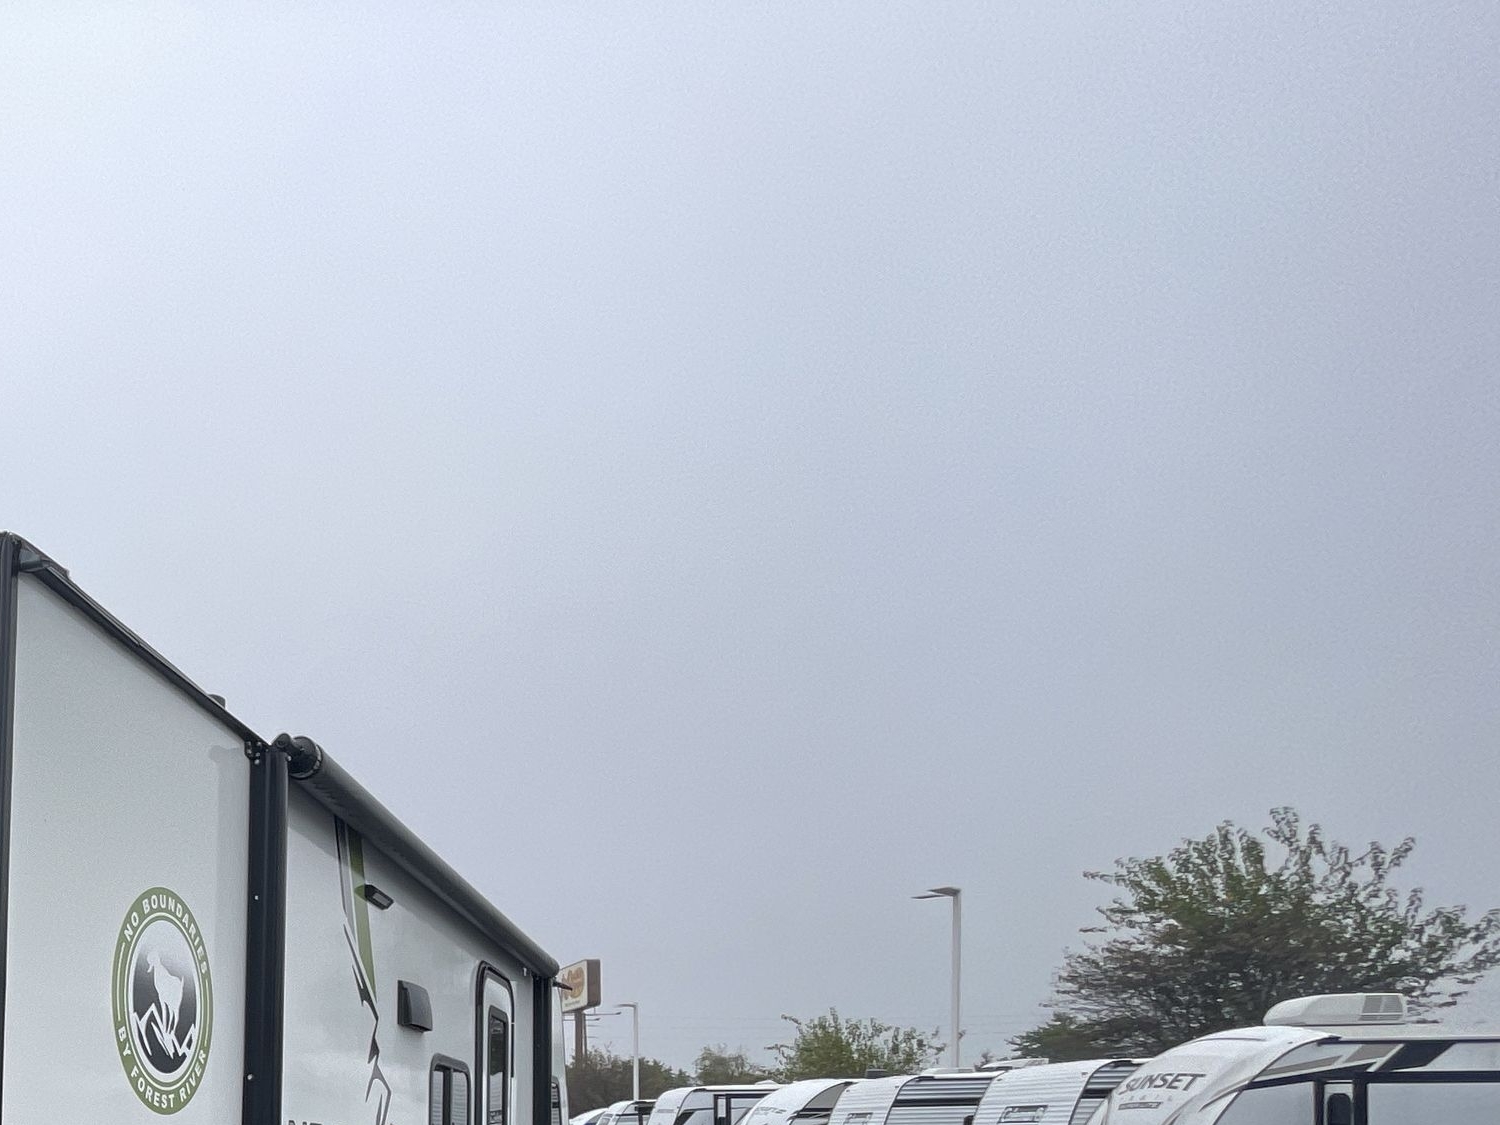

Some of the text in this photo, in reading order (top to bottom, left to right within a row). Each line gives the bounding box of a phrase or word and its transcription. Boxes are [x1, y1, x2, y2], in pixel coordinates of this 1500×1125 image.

[123, 894, 208, 975] NO BOUNDARIES
[118, 1025, 207, 1109] BY FOREST RIVER
[1117, 1072, 1207, 1096] SUNSET
